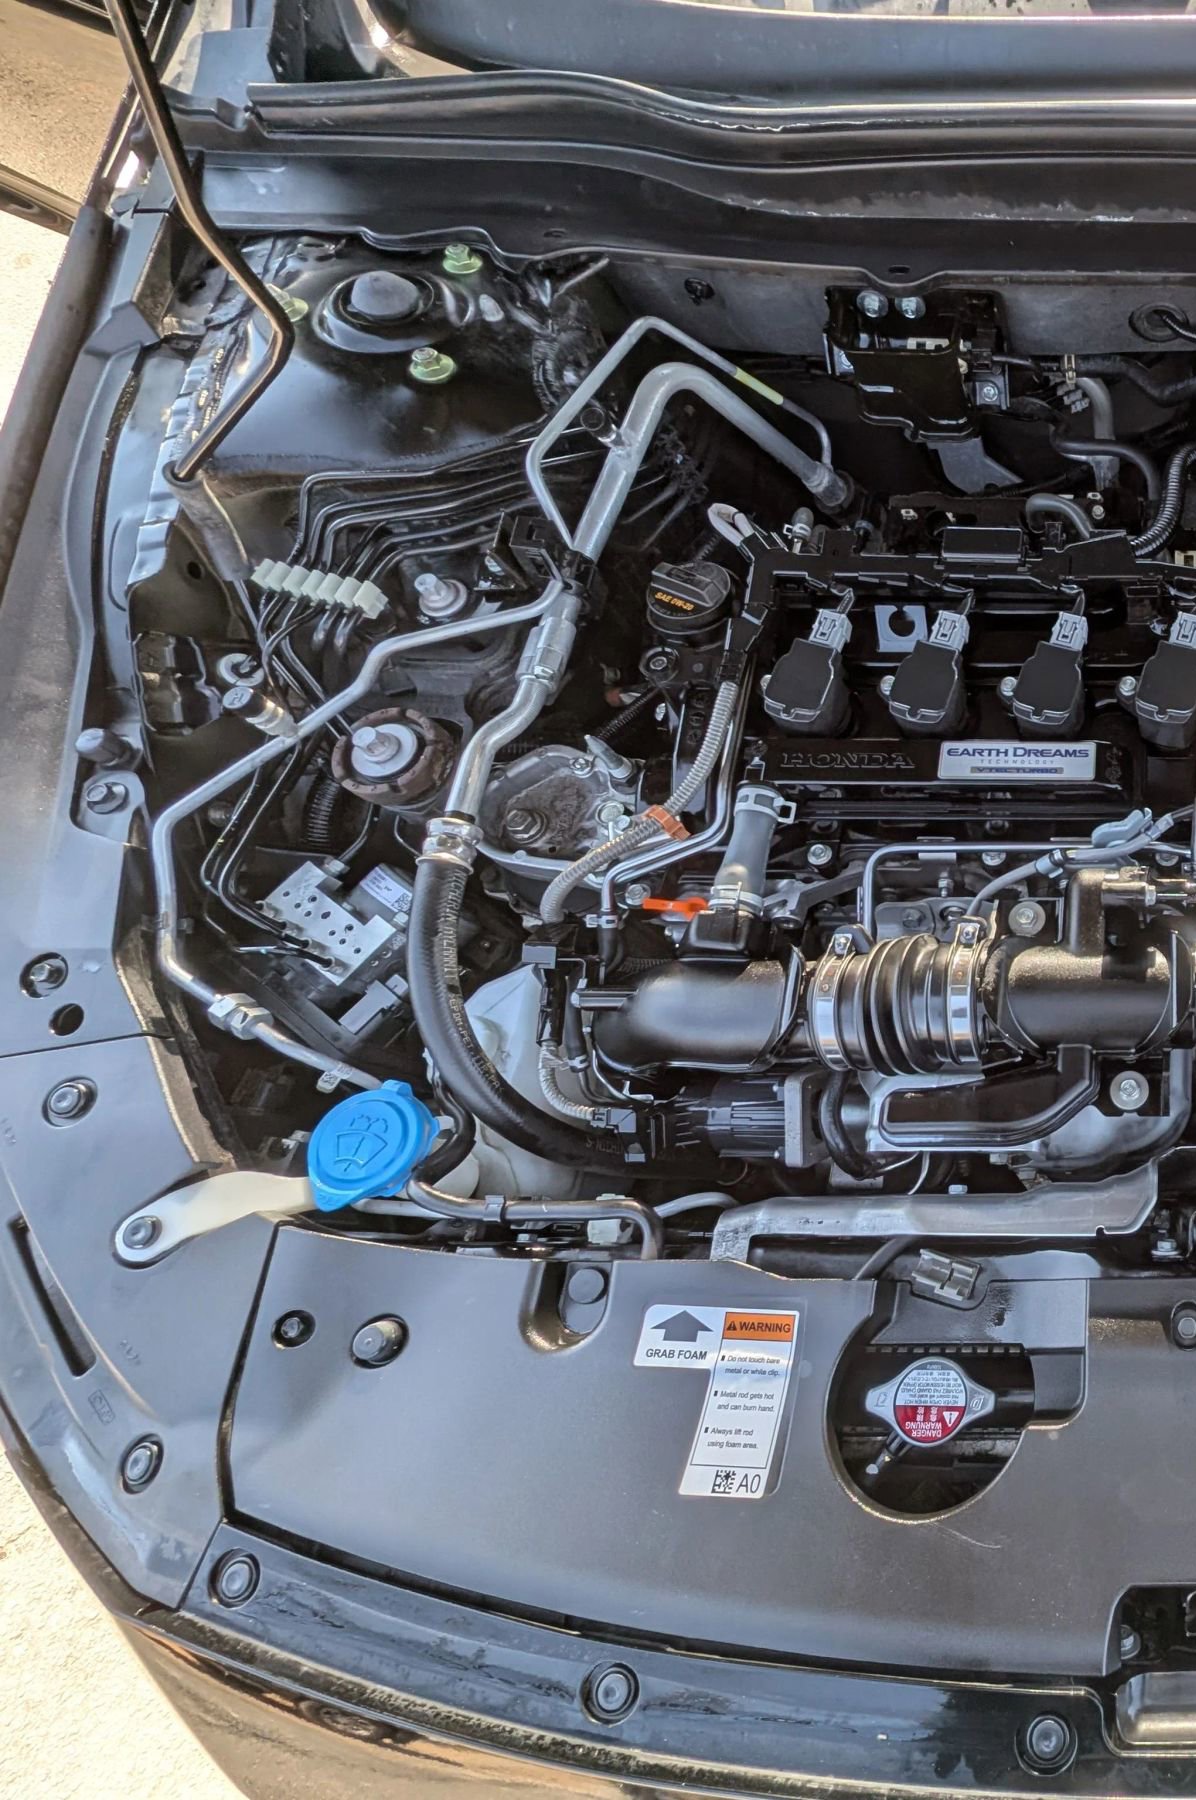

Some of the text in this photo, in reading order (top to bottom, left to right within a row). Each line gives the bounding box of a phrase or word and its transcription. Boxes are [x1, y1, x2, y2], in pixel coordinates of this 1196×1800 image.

[655, 592, 672, 603] SAE
[671, 598, 694, 610] 0W-20
[946, 747, 1089, 758] EARTH DREAMS
[780, 752, 916, 768] HONDA
[739, 1321, 791, 1333] WARNING
[646, 1348, 708, 1360] GRAB FOAM
[749, 1392, 763, 1400] gets
[905, 1421, 942, 1430] WARNUNG
[710, 1427, 733, 1436] Always
[911, 1429, 942, 1438] DANGER
[736, 1473, 762, 1494] A0
